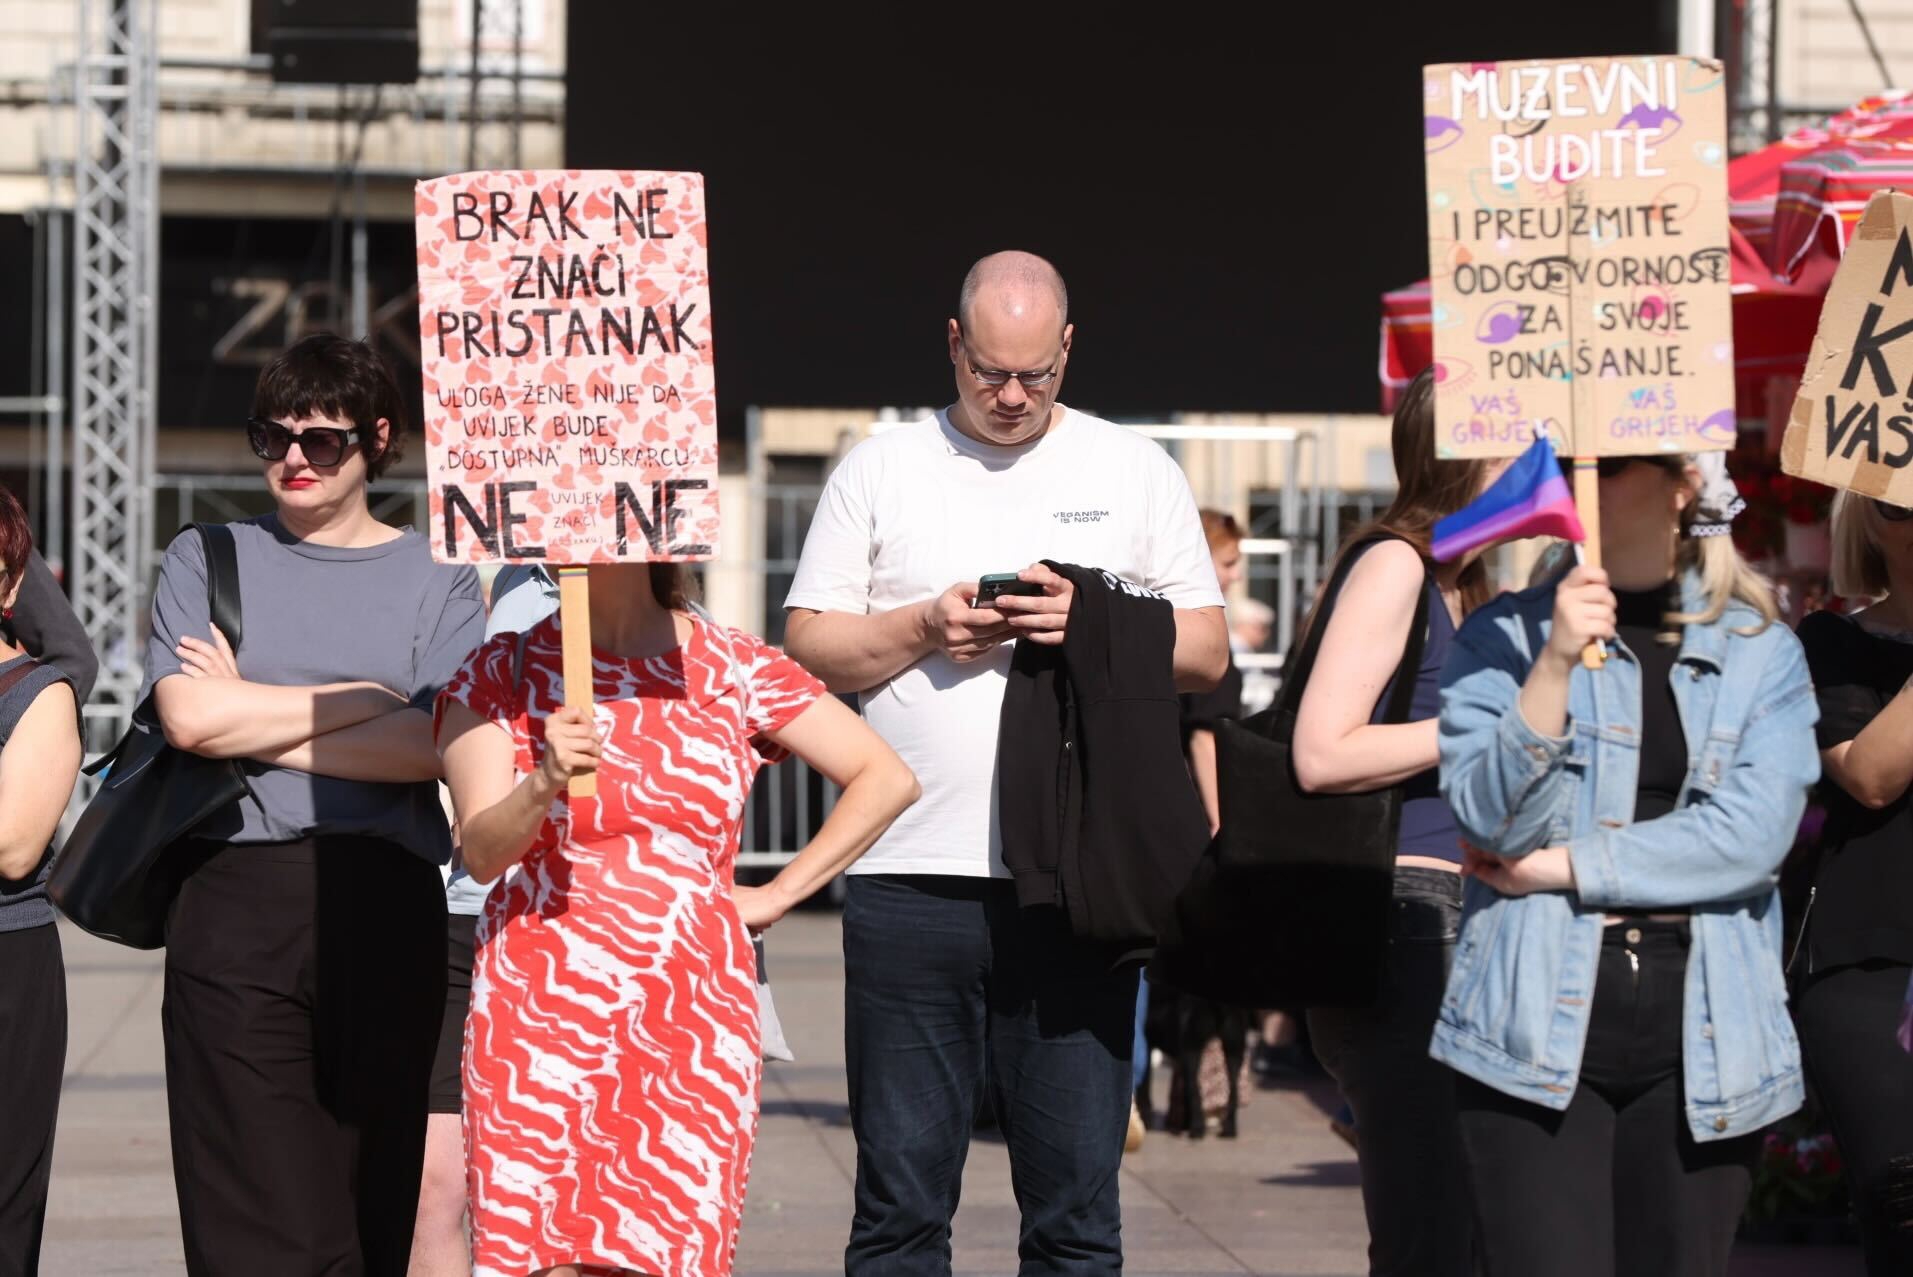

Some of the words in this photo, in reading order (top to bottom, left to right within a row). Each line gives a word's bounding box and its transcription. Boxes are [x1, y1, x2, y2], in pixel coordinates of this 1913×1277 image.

[1450, 59, 1679, 121] MUŽEVNI
[1489, 127, 1667, 185] BUDITE
[453, 190, 589, 242] BRAK
[613, 188, 674, 240] NE
[1452, 210, 1461, 241] I
[510, 243, 627, 300] ZNAČI
[1516, 303, 1563, 335] ZA
[1599, 300, 1691, 332] SVOJE
[1489, 339, 1696, 381] PONAŠANJE.
[437, 386, 507, 408] ULOGA
[521, 379, 577, 405] ŽENE
[593, 384, 639, 405] NIJE
[652, 383, 682, 404] DA
[1470, 387, 1522, 416] VAŠ
[464, 415, 537, 438] UVIJEK
[553, 415, 610, 437] BUDE
[1452, 417, 1548, 444] GRIJE
[551, 491, 603, 505] UVIJEK
[1052, 510, 1110, 519] VEGANISM
[442, 480, 547, 559] NE
[614, 478, 712, 556] NE
